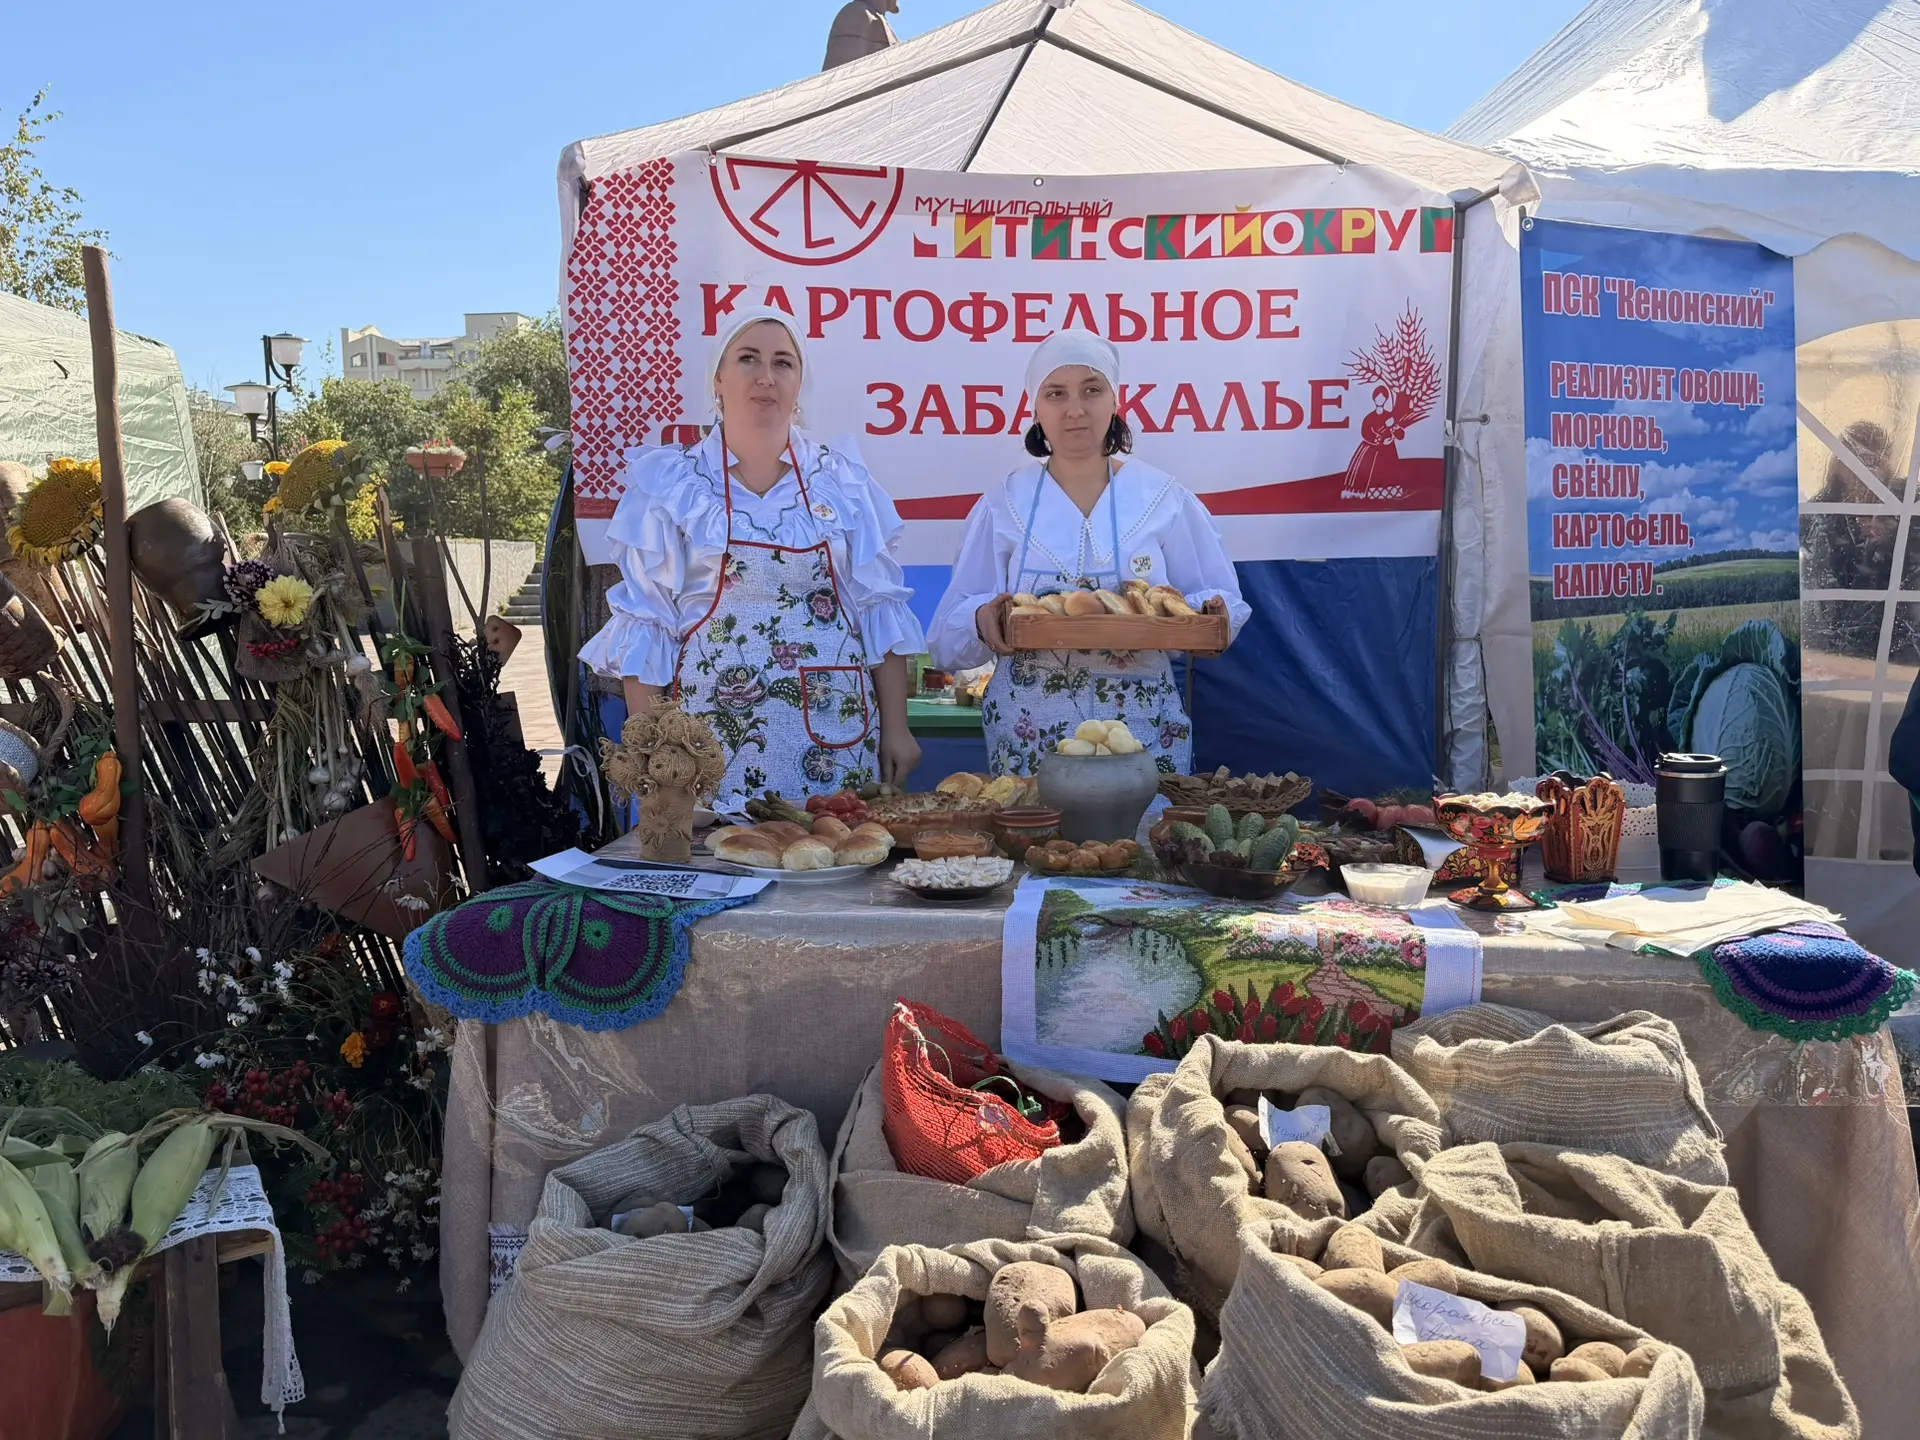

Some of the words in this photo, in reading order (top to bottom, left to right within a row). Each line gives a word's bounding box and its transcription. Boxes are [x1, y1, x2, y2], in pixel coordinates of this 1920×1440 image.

[914, 195, 1114, 218] МУНИЦИПАЛЬНЫЙ
[1542, 271, 1600, 317] ПСК
[1604, 277, 1775, 329] "Кенонский"
[865, 378, 1351, 435] ЗАБАКАЛЬЕ
[1550, 361, 1675, 402] РЕАЛИЗУЕТ
[1679, 368, 1765, 410] ОВОЩИ:
[1551, 412, 1668, 454] МОРКОВЬ,
[1551, 458, 1645, 501] СВЁКЛУ,
[1552, 512, 1695, 549] КАРТОФЕЛЬ,
